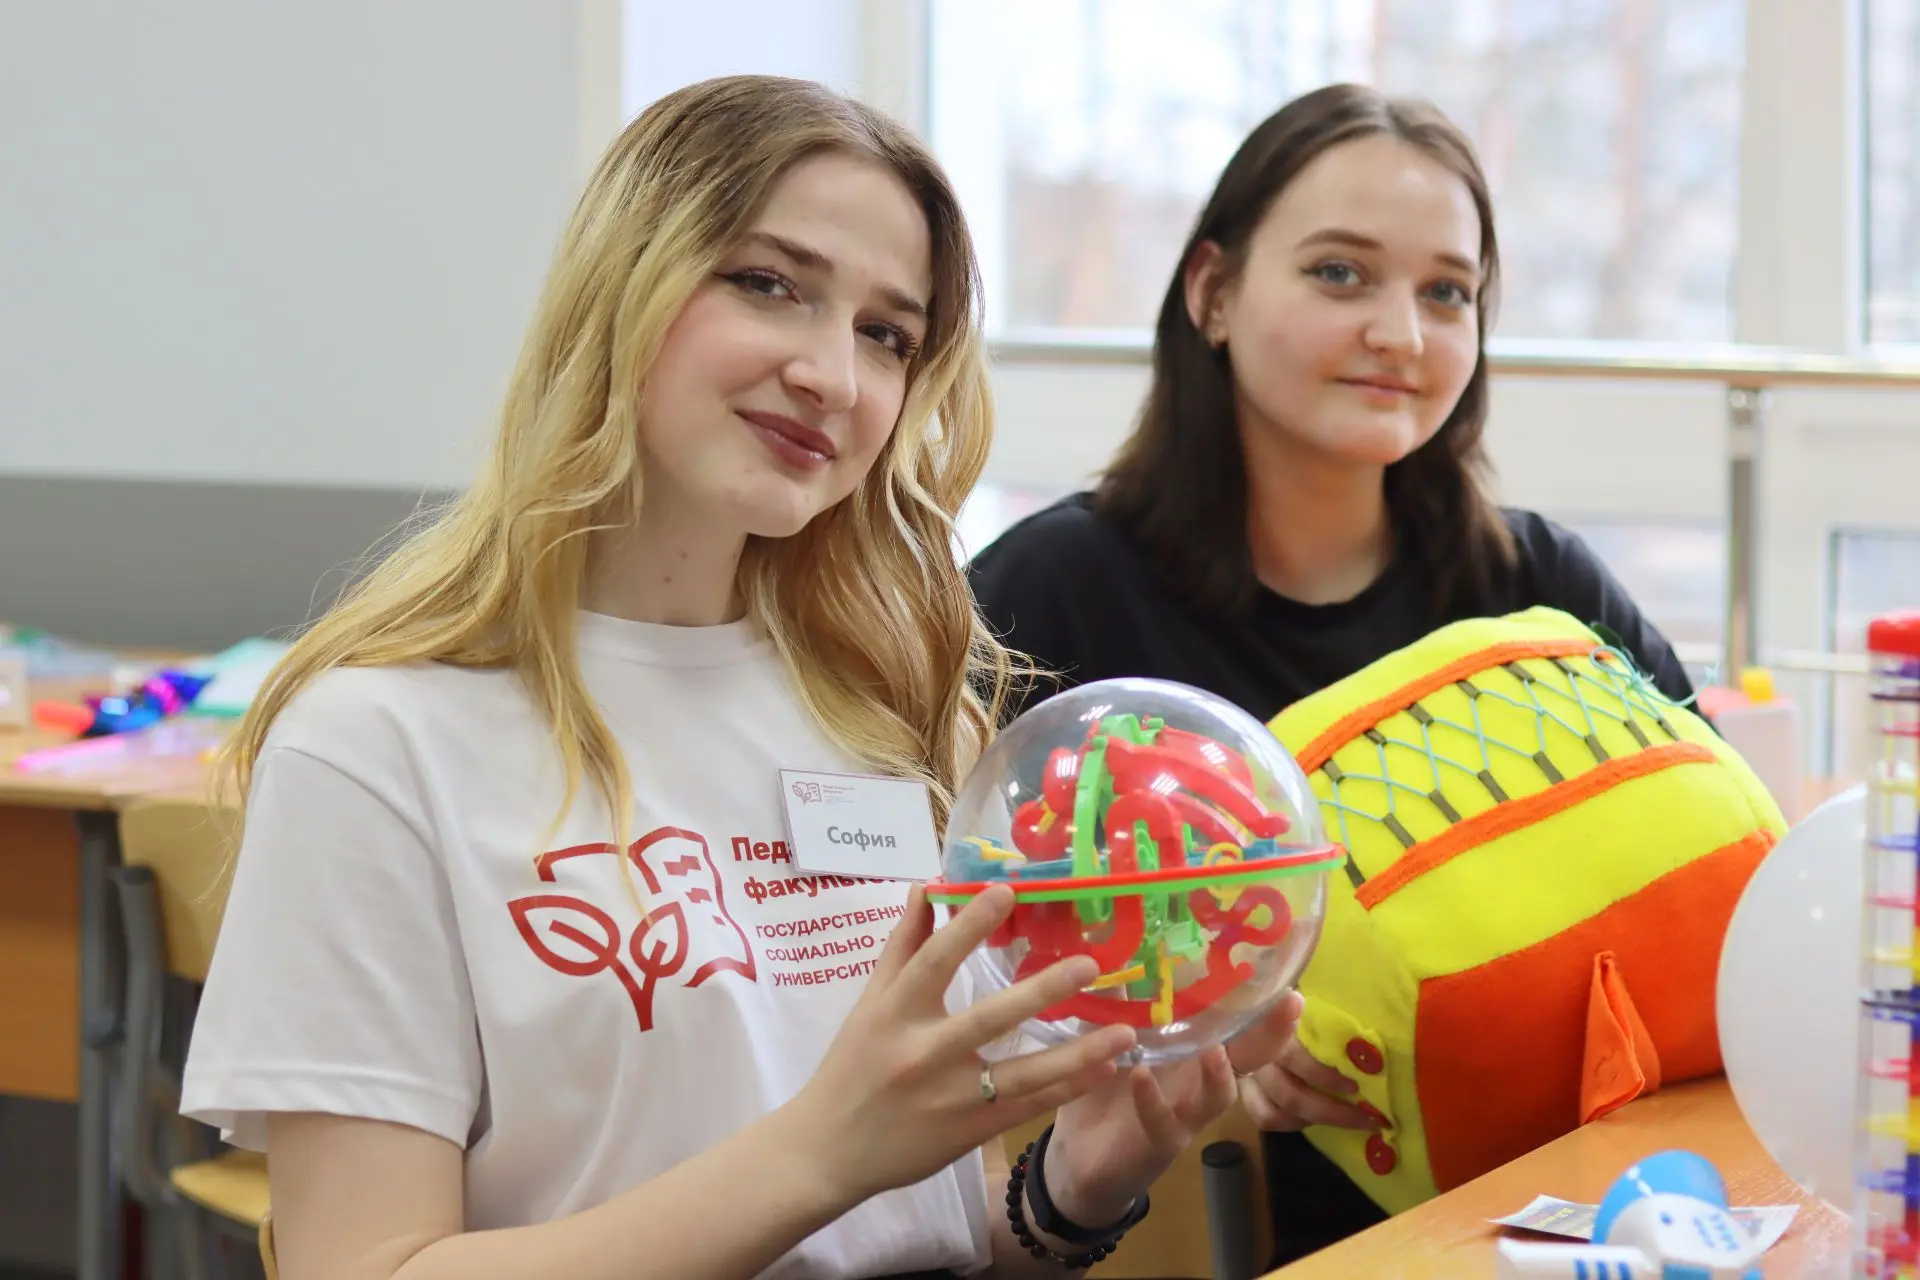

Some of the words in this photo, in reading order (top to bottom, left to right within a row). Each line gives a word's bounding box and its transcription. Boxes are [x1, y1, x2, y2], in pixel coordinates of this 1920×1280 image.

[731, 836, 792, 864] Пед
[827, 826, 896, 851] София
[766, 934, 875, 963] СОЦИАЛЬНО
